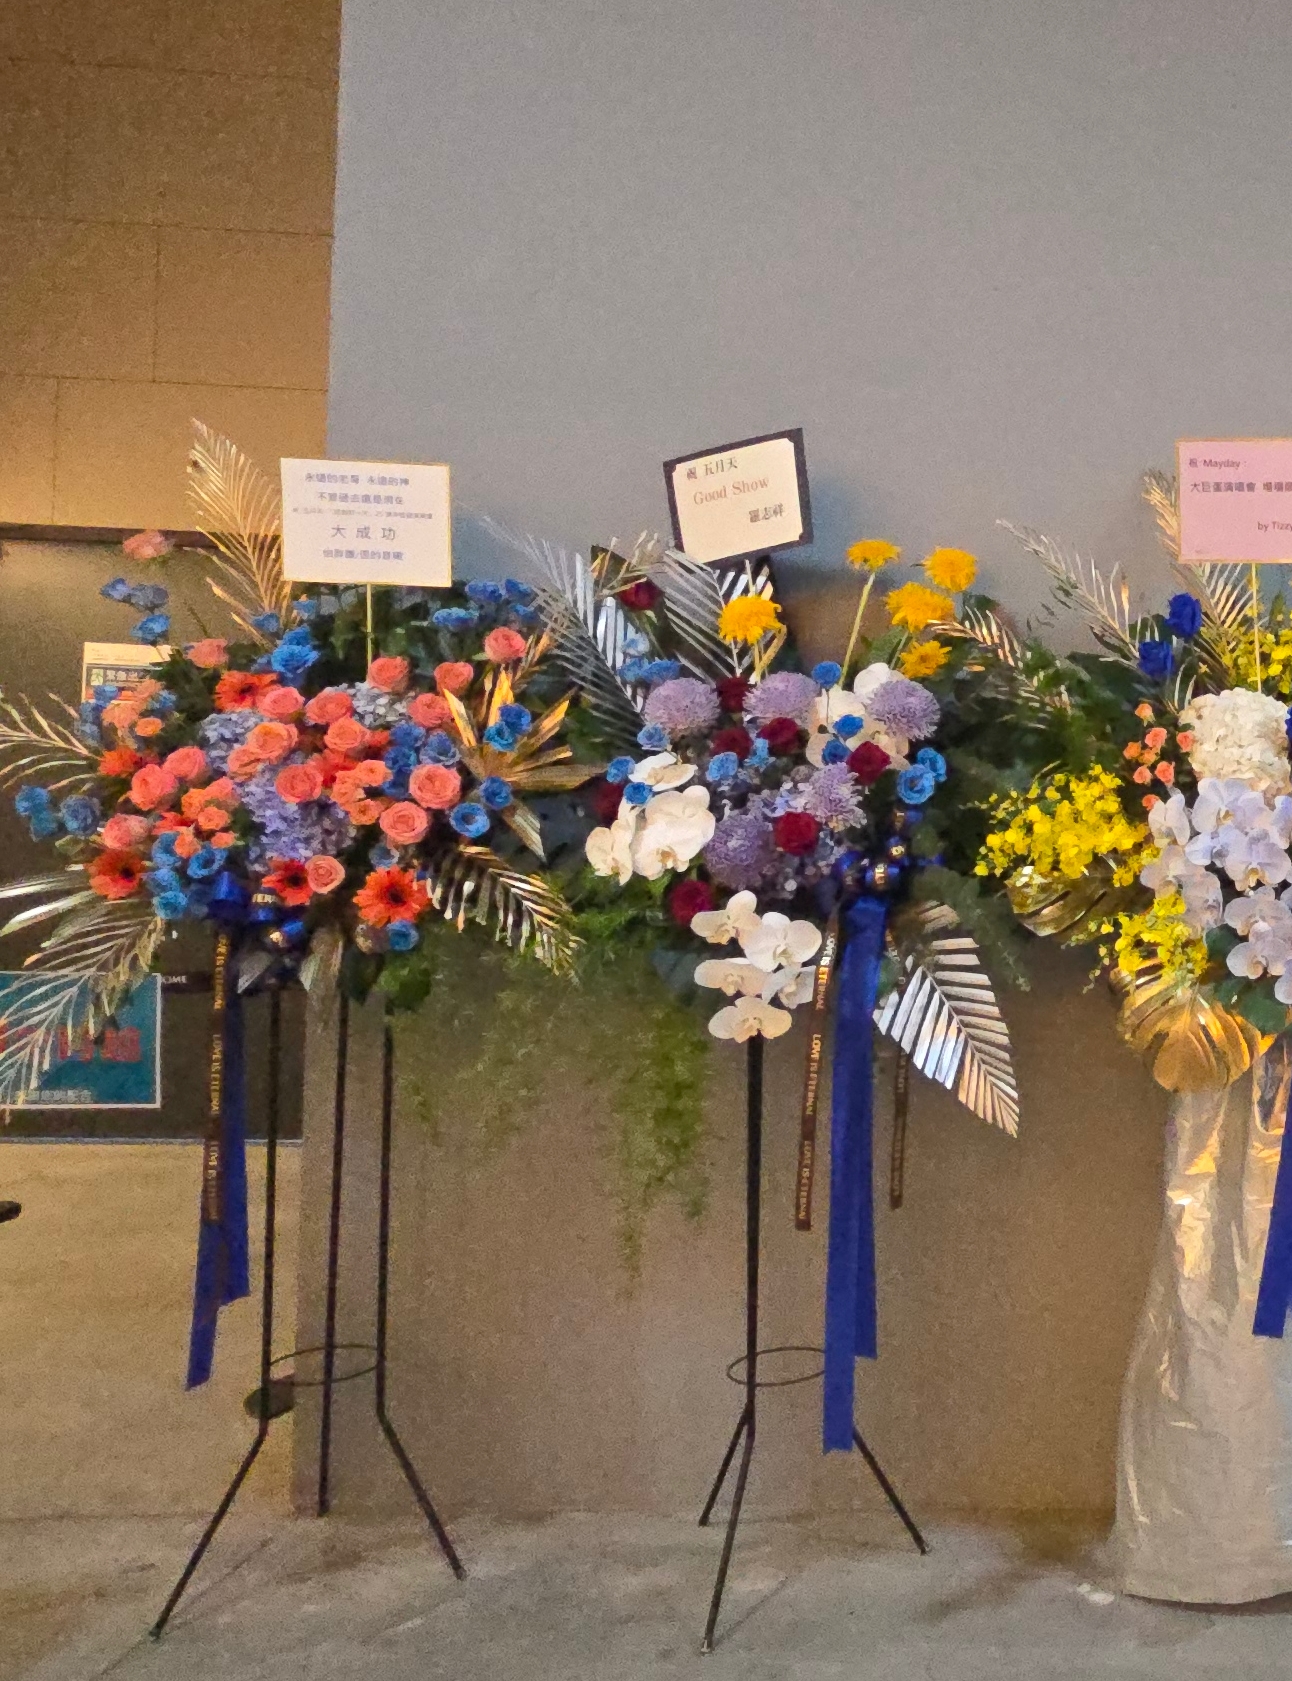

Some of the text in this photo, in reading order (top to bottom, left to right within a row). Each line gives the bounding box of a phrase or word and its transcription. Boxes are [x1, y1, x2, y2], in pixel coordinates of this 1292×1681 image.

[704, 456, 739, 477] 五月天
[693, 476, 770, 506] Good Show
[1190, 481, 1256, 493] 大巨蛋演唱會
[748, 502, 784, 524] 羅志祥
[1257, 521, 1268, 532] by
[823, 933, 836, 956] LOVE
[815, 967, 829, 1010] ETERNAL
[212, 1034, 222, 1060] LOVE
[810, 1034, 822, 1060] LOVE
